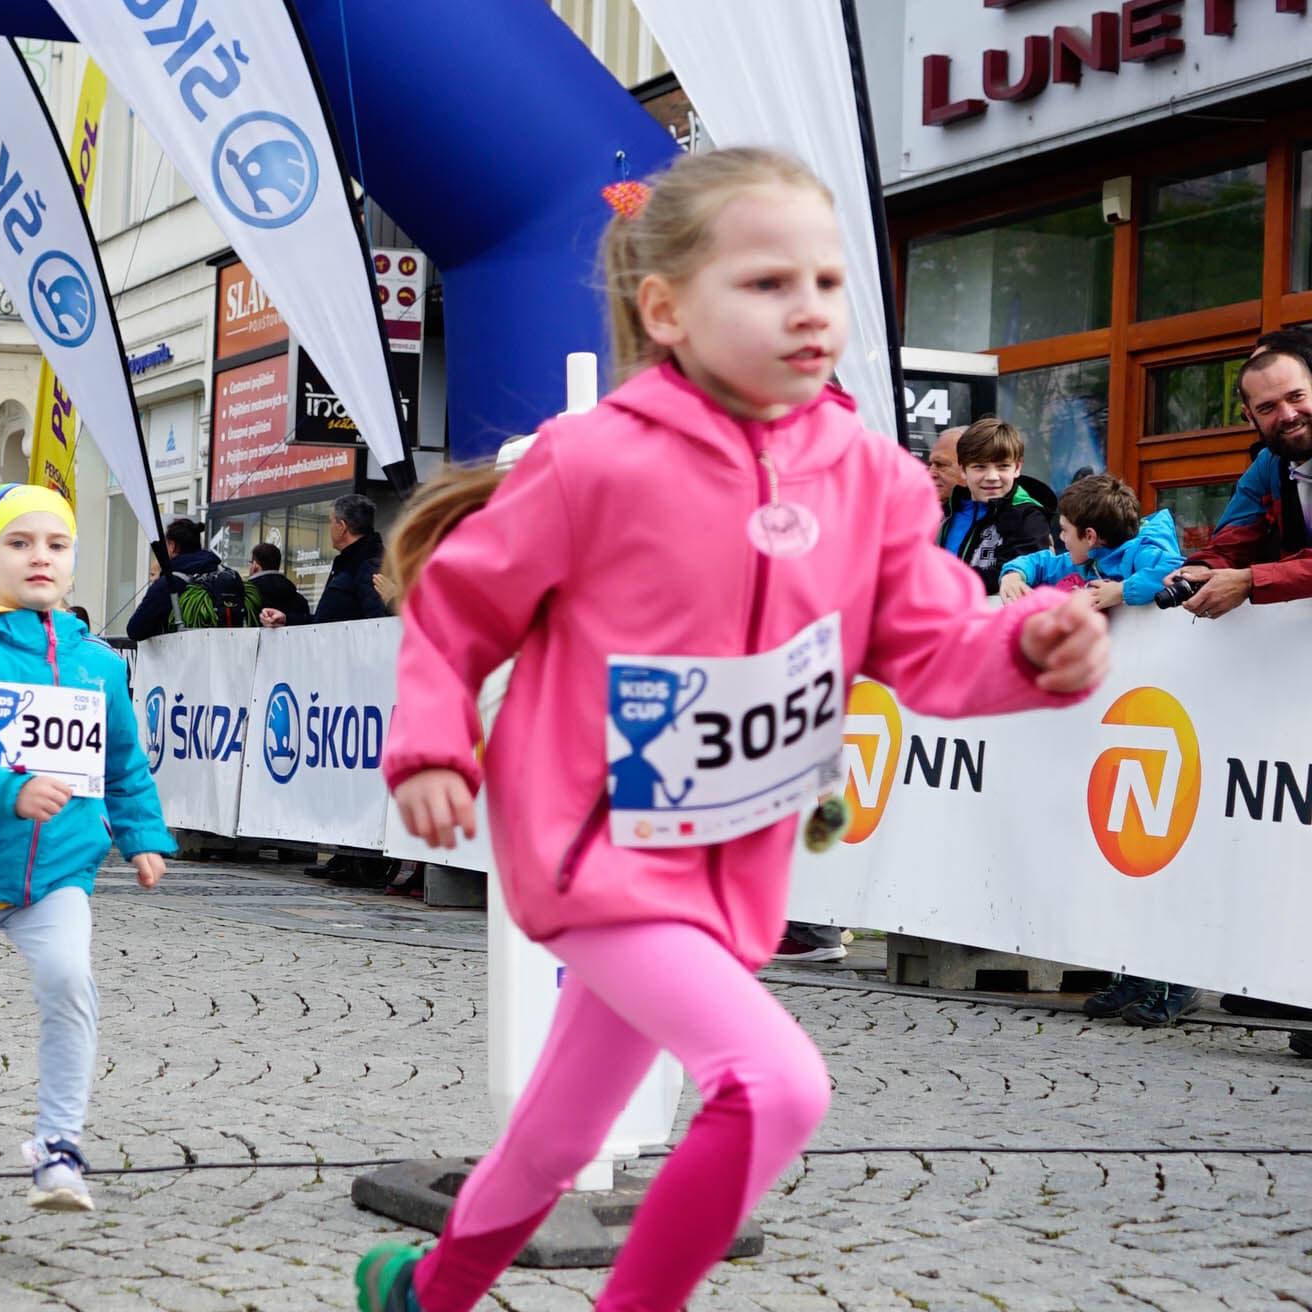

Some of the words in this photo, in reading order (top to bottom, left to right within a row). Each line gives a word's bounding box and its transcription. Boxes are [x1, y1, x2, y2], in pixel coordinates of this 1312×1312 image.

[618, 680, 670, 699] KIDS
[621, 701, 666, 720] CUP
[21, 714, 102, 754] 3004
[693, 669, 835, 769] 3052
[904, 734, 985, 793] NN
[1225, 757, 1312, 826] NN
